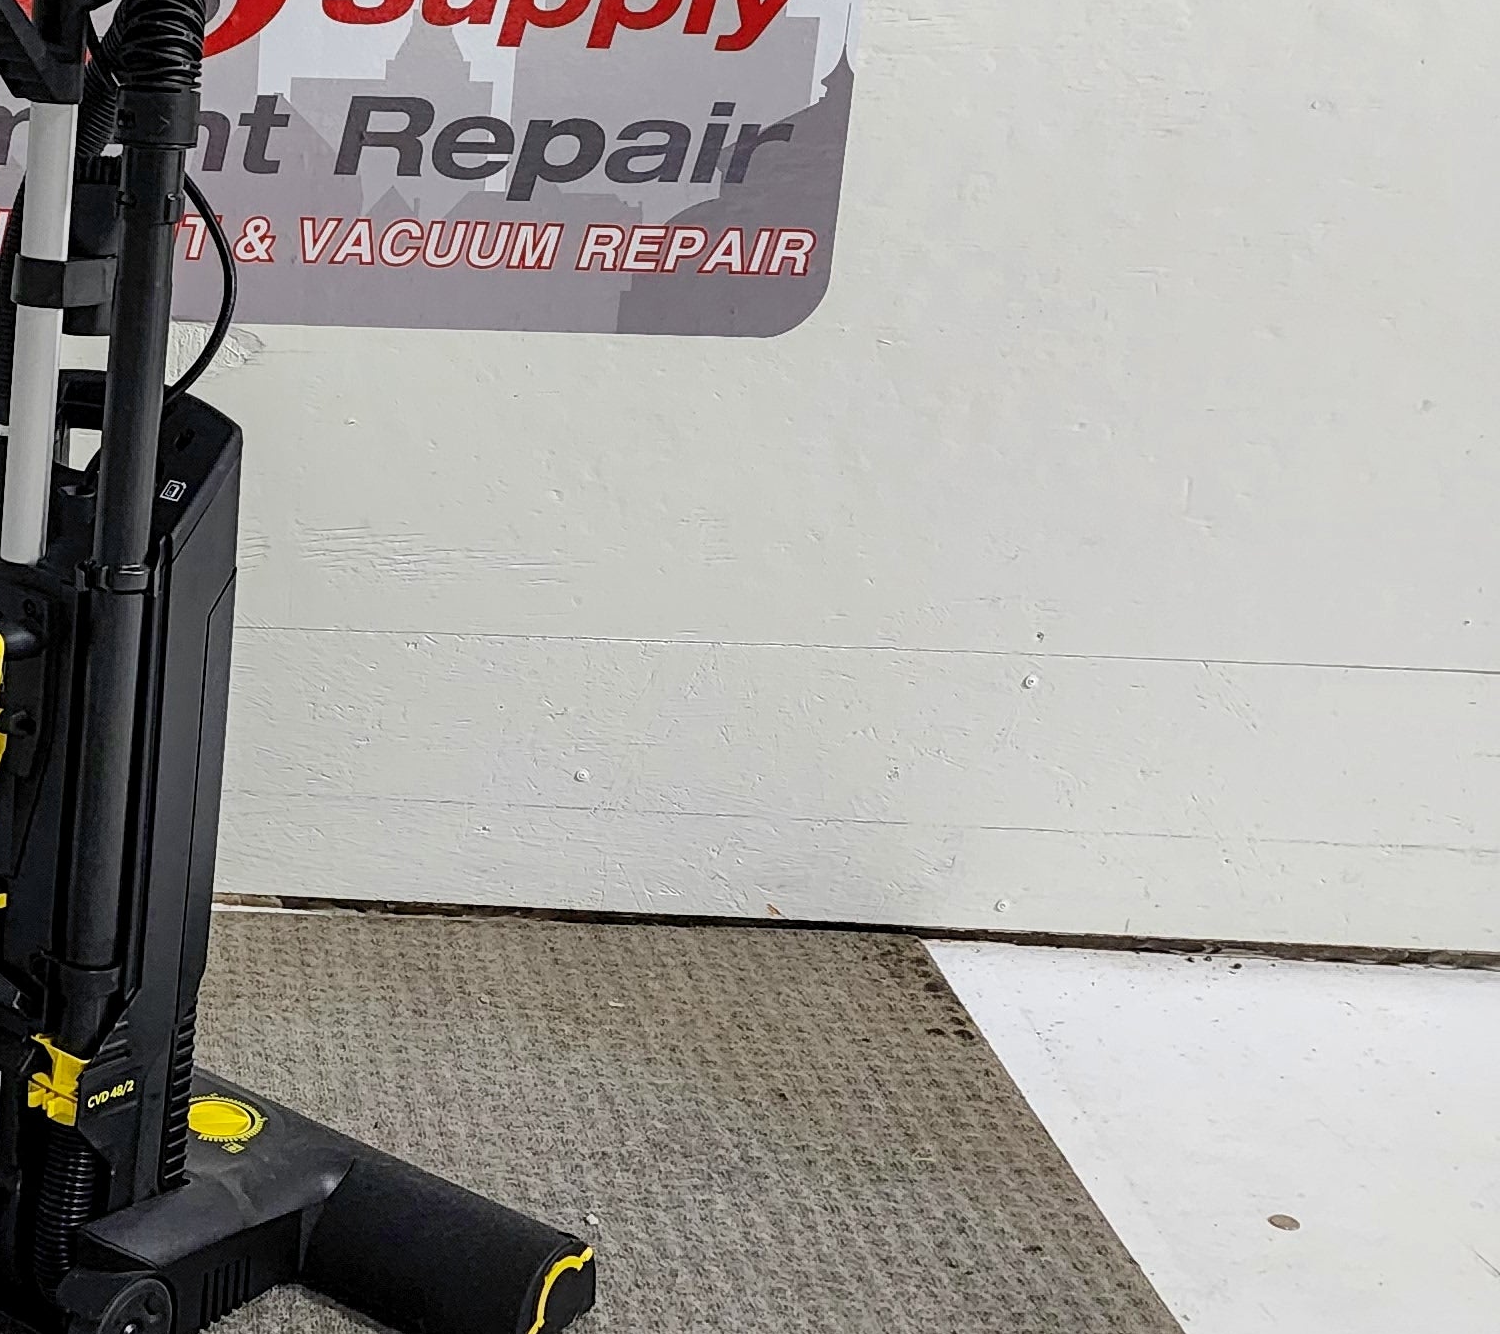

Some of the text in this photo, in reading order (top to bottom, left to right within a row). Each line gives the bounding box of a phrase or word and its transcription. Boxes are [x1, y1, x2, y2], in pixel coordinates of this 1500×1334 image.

[334, 95, 794, 202] Repair
[233, 216, 276, 262] &
[299, 217, 560, 269] VACUUM
[576, 224, 817, 276] REPAIR
[88, 1080, 134, 1108] CVD 48/2
